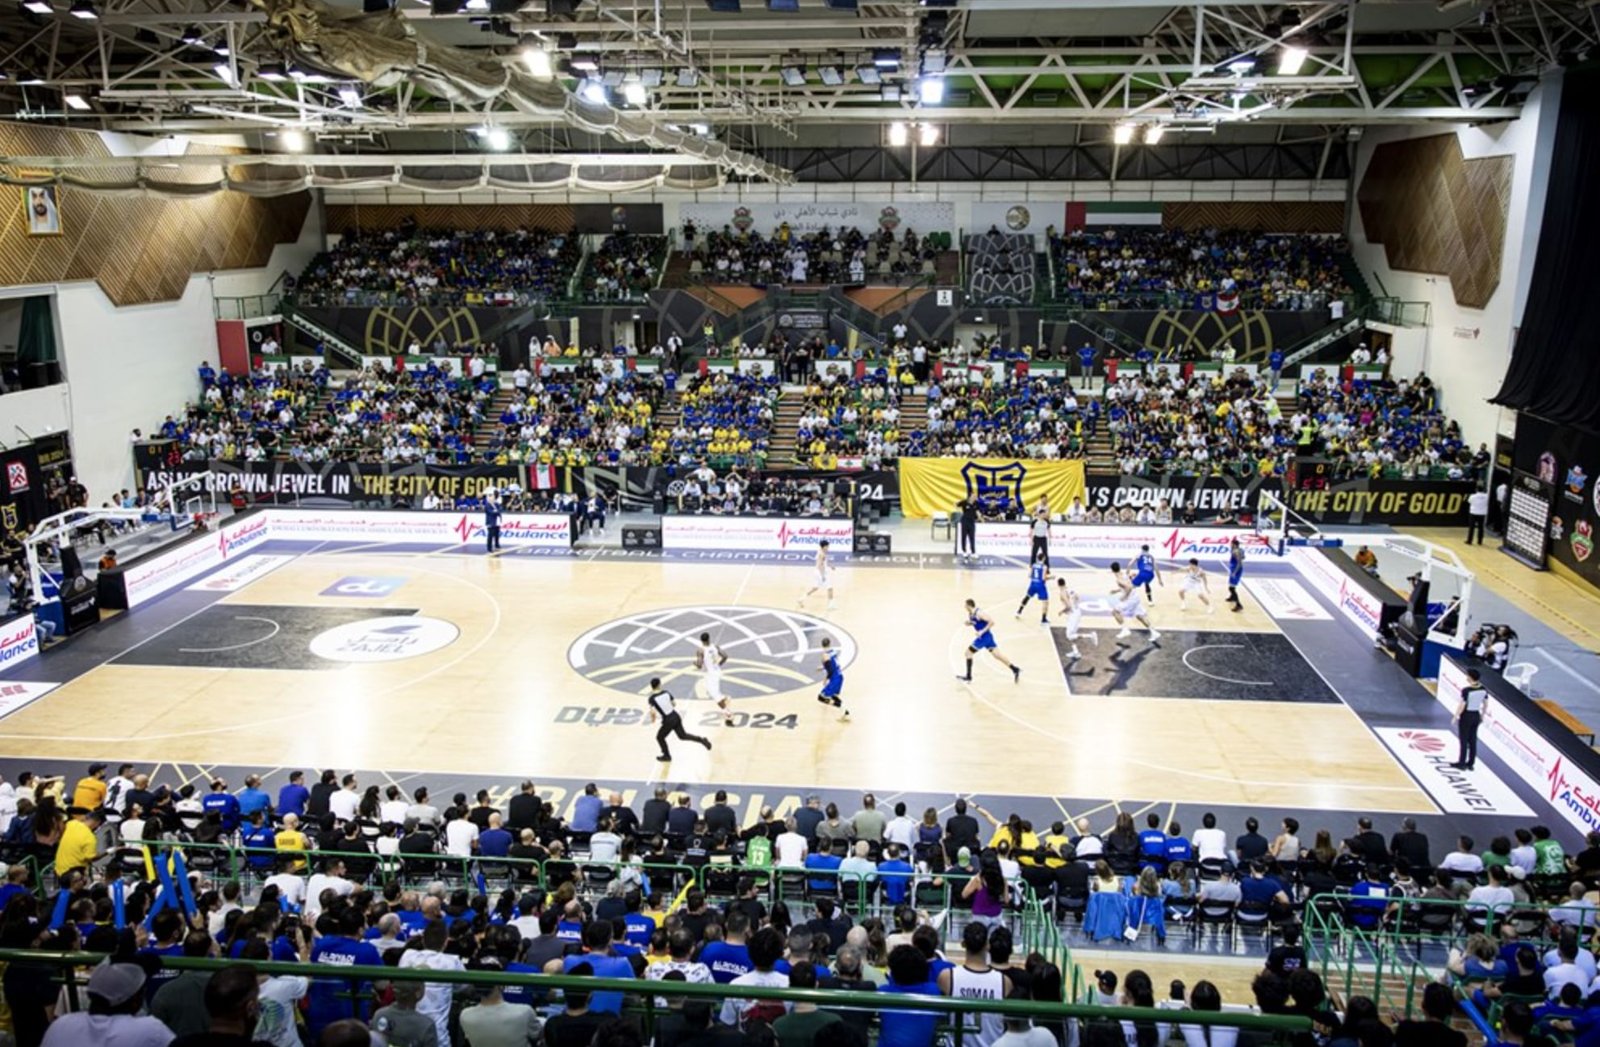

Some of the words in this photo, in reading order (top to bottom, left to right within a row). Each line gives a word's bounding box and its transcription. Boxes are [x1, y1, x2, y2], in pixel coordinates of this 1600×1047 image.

[205, 473, 267, 494] CROWN
[270, 474, 325, 494] JEWEL
[332, 475, 350, 495] IN
[397, 475, 436, 496] CITY
[438, 476, 460, 497] OF
[1113, 488, 1186, 509] CROWN
[1333, 491, 1379, 514] CITY
[1380, 492, 1409, 514] OF
[472, 530, 569, 540] Abulance
[788, 535, 852, 546] Ambuance
[698, 710, 799, 730] 2024
[1424, 754, 1497, 812] HUAWEI
